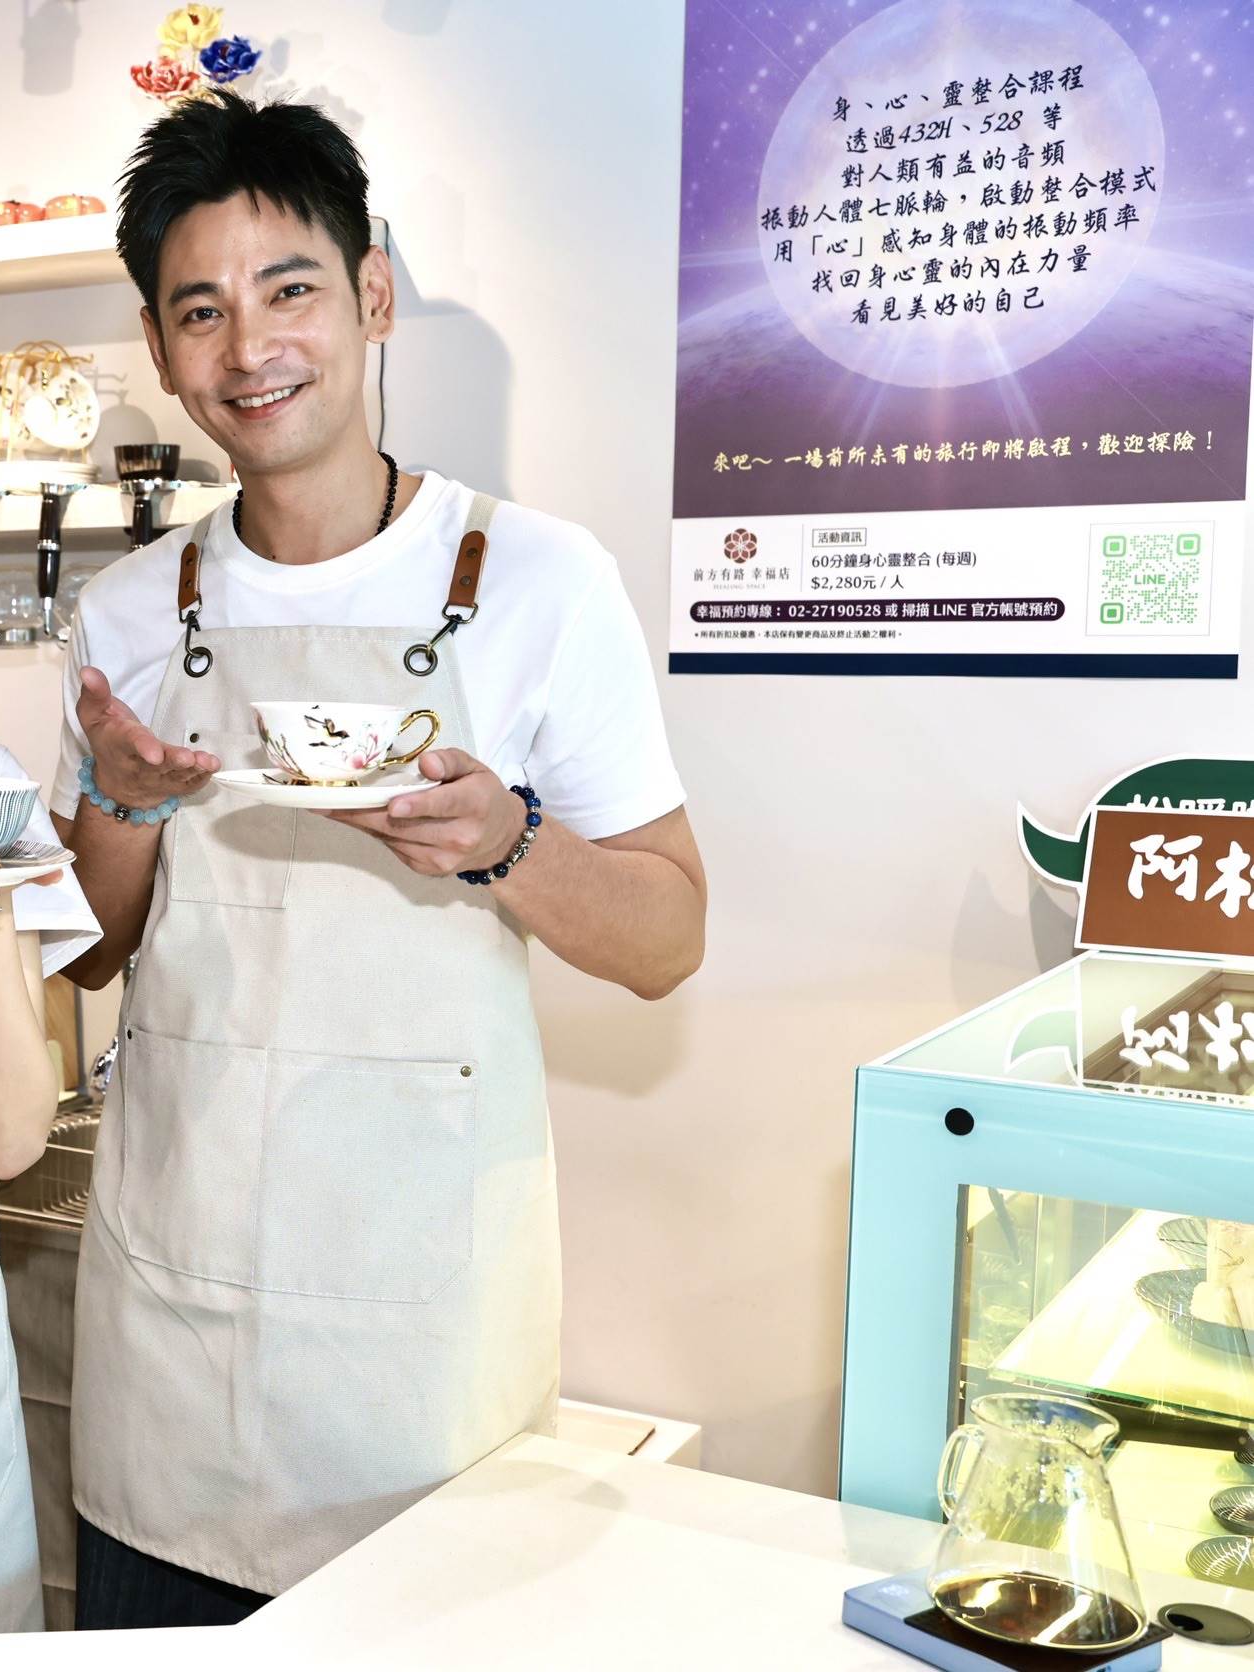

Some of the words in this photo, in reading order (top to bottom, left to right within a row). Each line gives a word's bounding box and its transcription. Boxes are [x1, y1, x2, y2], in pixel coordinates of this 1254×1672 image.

[832, 65, 1084, 122] 身、心、靈整合課程
[845, 110, 1023, 154] 透過432H、528
[1043, 103, 1063, 130] 等
[841, 140, 1065, 188] 對人類有益的音頻
[761, 166, 1156, 231] 振動人體七脈輪，啟動整合模式
[774, 203, 1140, 263] 用「心」感知身體的振動頻率
[812, 245, 1091, 292] 找回身心靈的內在力量
[850, 287, 1044, 325] 看見美好的自己
[713, 452, 772, 473] 來吧～
[784, 430, 1213, 469] 一場前所未有的旅行即將啟程，歡迎探險！
[818, 531, 862, 544] 活動資訊
[694, 568, 744, 581] 前方有路
[752, 567, 790, 581] 幸福店
[812, 552, 931, 568] 60分鐘身心靈整合
[936, 551, 977, 568] (每週)
[1134, 574, 1166, 585] LINE
[811, 575, 876, 590] $2,280元
[890, 574, 904, 589] 人
[697, 604, 782, 619] 幸福預約專線：
[788, 603, 881, 617] 02-27190528
[885, 603, 898, 617] 或
[902, 602, 929, 617] 掃描
[933, 603, 967, 616] LINE
[971, 602, 1058, 617] 官方帳號預約
